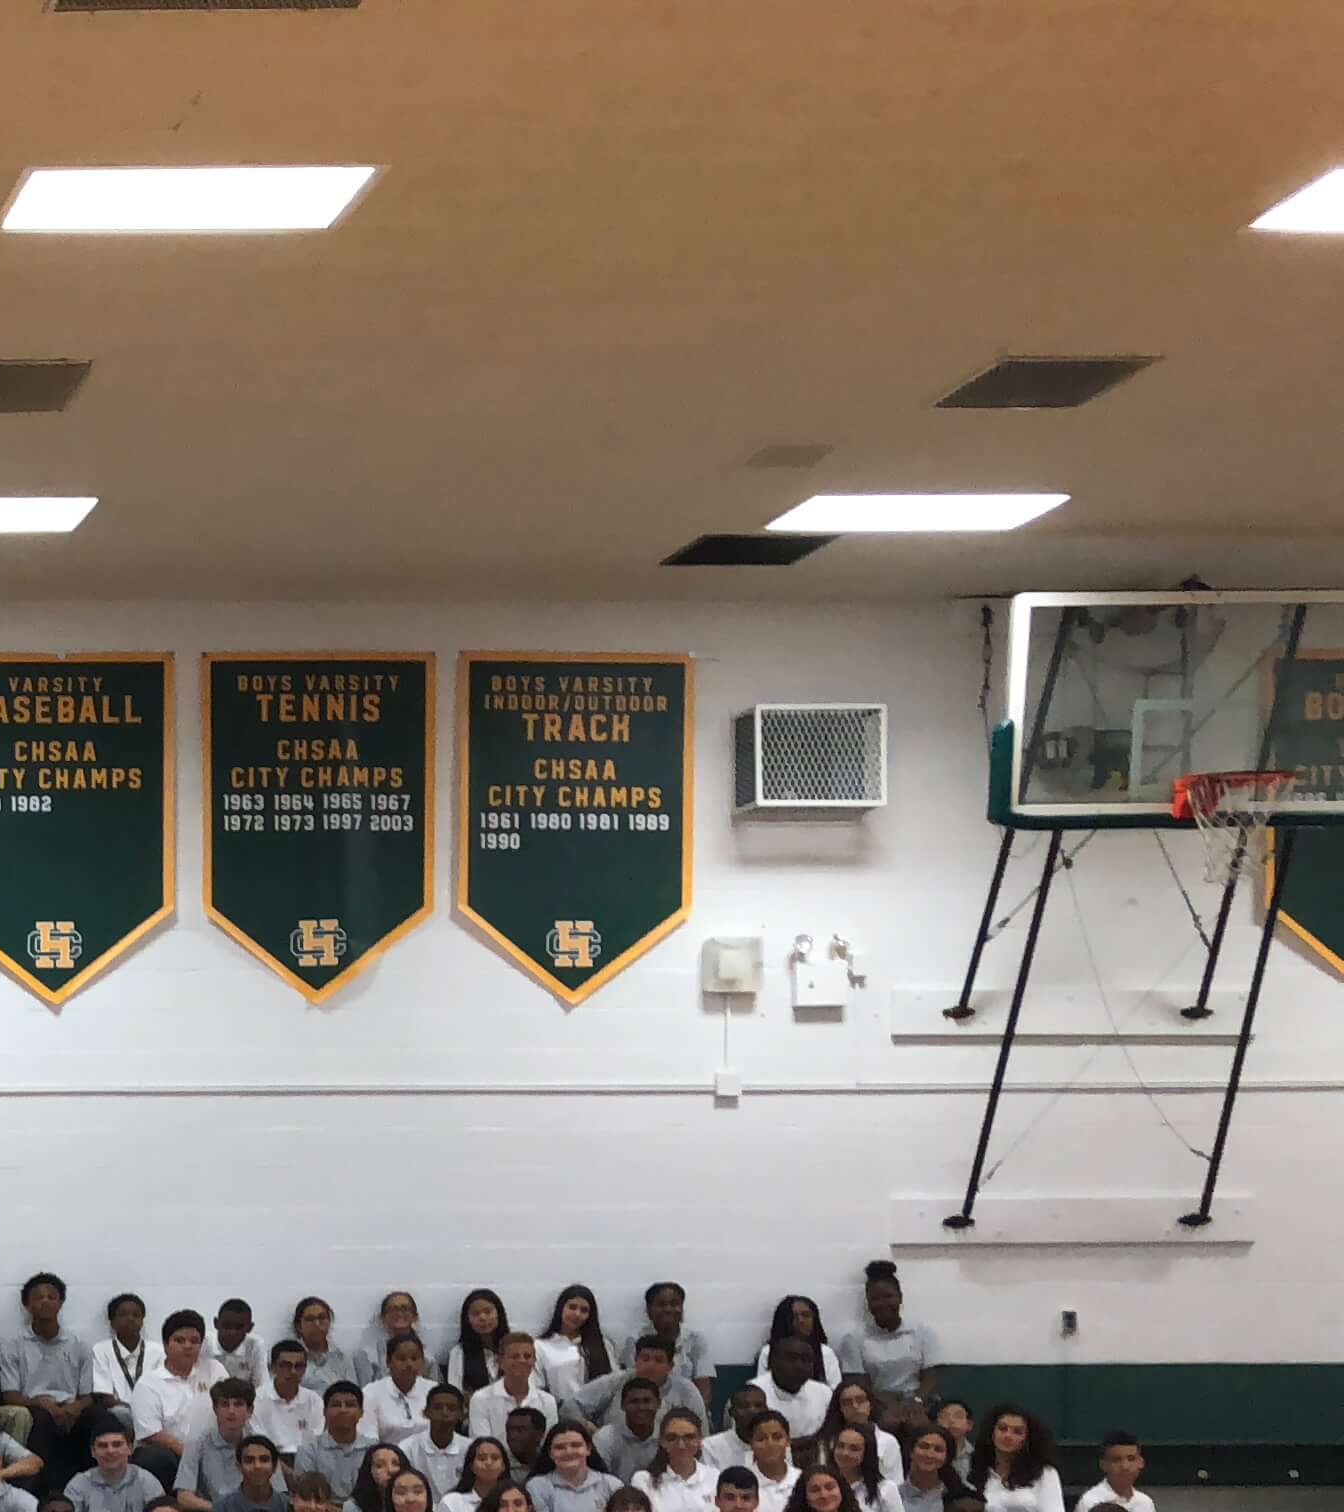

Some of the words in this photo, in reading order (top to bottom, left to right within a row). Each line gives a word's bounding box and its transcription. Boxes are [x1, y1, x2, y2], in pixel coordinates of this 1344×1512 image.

[9, 677, 101, 692] VARSITY
[238, 675, 291, 691] BOYS
[306, 675, 398, 691] VARSITY
[492, 676, 544, 693] BOYS
[559, 677, 652, 694] VARSITY
[256, 694, 380, 722] TENNIS
[523, 714, 629, 742] TRACK
[15, 741, 96, 761] CHSAA
[278, 739, 358, 760] CHSAA
[39, 768, 141, 789] CHAMPS
[232, 767, 288, 788] CITY
[301, 766, 402, 788] CHAMPS
[535, 759, 616, 780] CHSAA
[11, 796, 51, 811] 1982
[224, 794, 264, 810] 1963
[274, 795, 314, 810] 1964
[323, 793, 362, 809] 1965
[371, 794, 410, 810] 1967
[489, 785, 545, 806] CITY
[559, 787, 661, 808] CHAMPS
[224, 815, 264, 831] 1972
[275, 815, 314, 830] 1973
[323, 814, 361, 830] 1997
[370, 815, 413, 831] 2003
[481, 813, 519, 829] 1961
[531, 813, 571, 829] 1980
[580, 813, 618, 830] 1981
[629, 814, 669, 830] 1989
[480, 833, 520, 849] 1990
